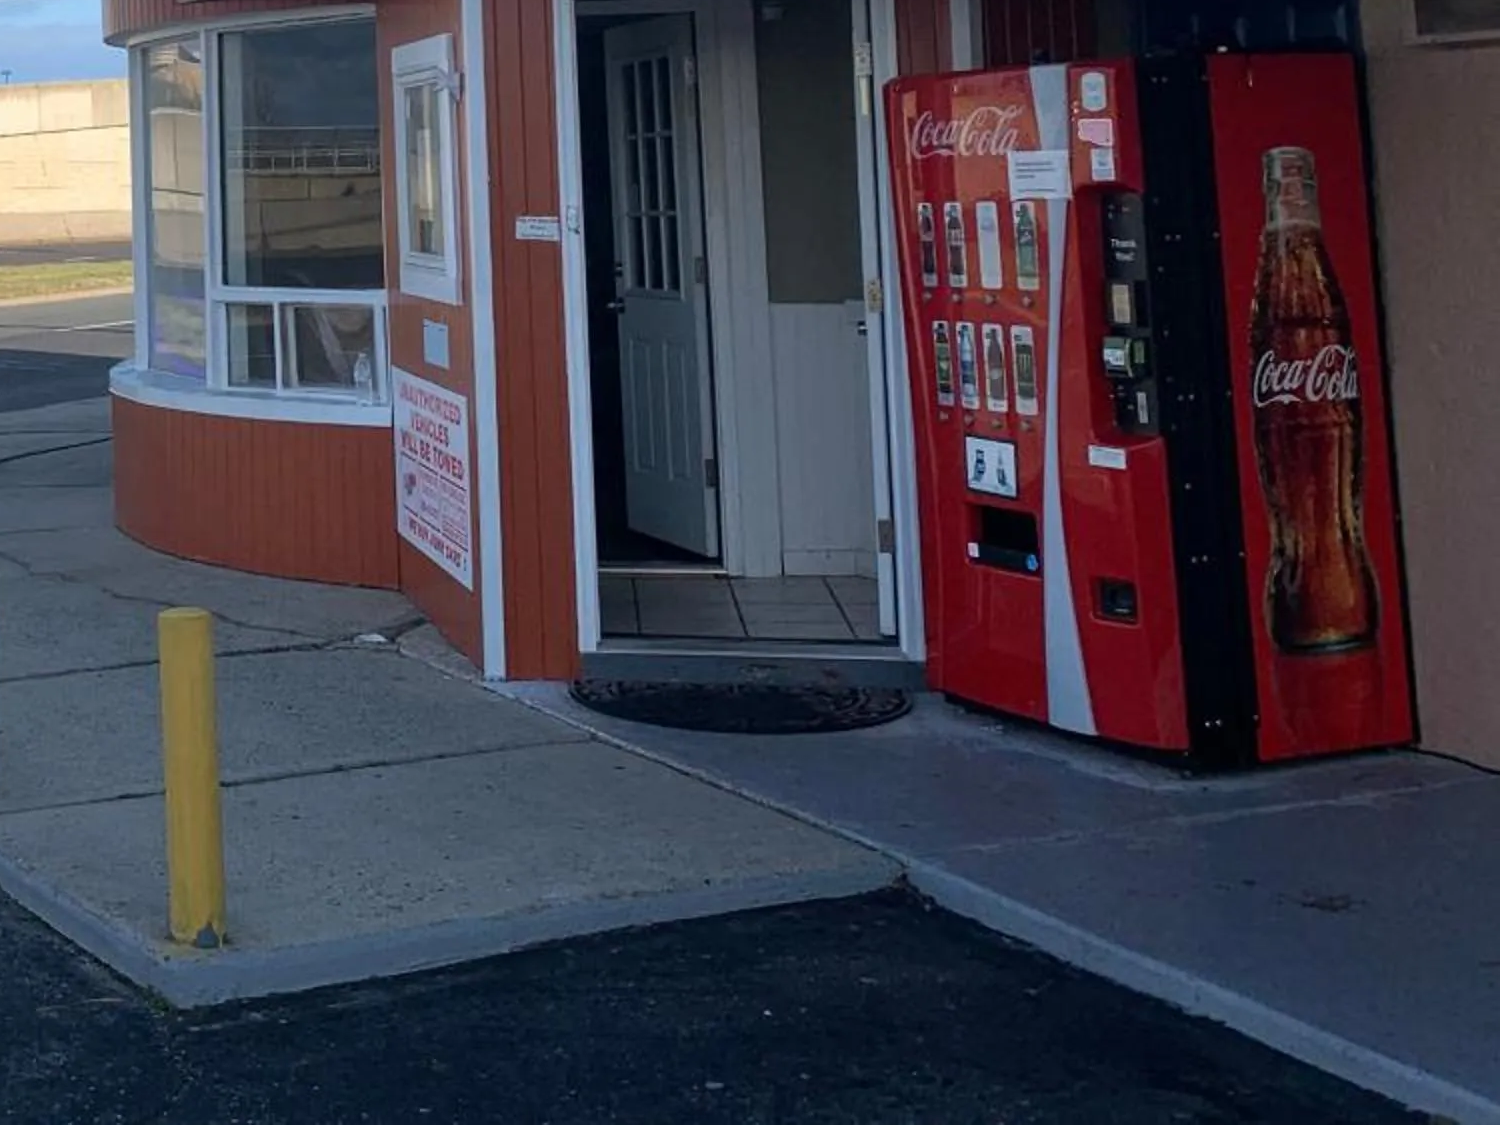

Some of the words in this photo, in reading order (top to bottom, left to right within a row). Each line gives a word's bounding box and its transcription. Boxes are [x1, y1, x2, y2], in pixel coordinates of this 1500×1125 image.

[1253, 344, 1358, 408] Coca-Cola
[419, 440, 431, 461] BE
[432, 446, 464, 481] TOWED
